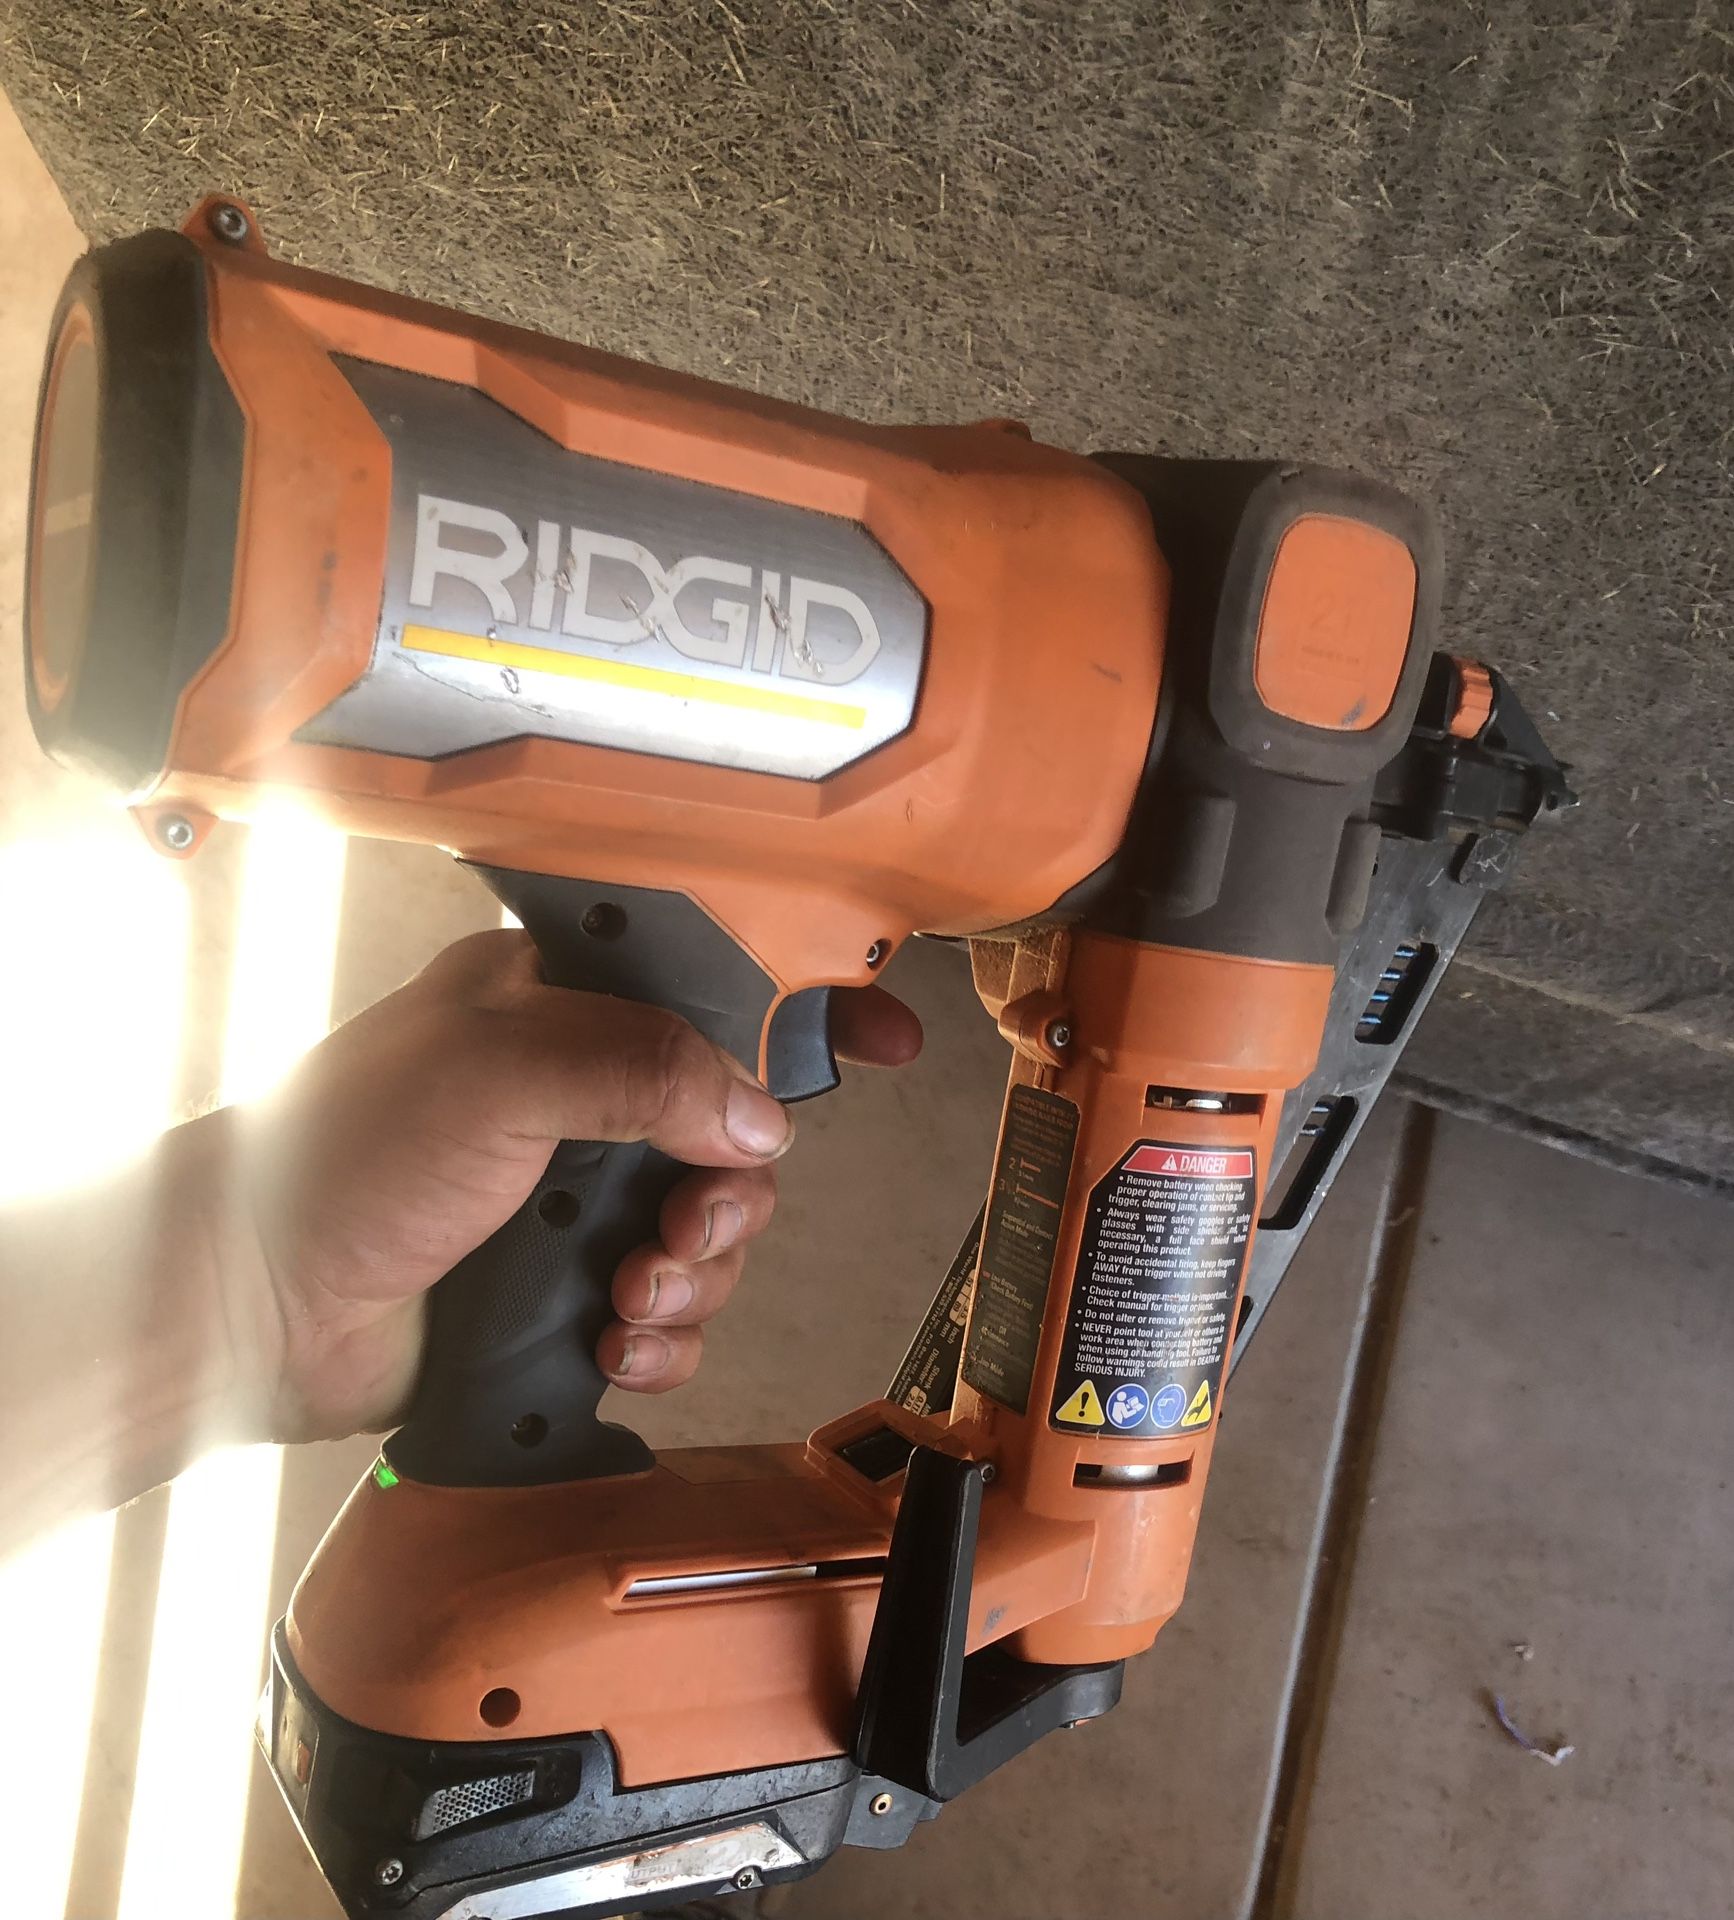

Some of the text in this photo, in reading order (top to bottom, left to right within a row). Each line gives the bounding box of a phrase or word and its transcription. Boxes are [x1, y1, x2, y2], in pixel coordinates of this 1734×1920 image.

[409, 494, 882, 687] RIDGID
[1180, 1155, 1227, 1173] DANGER
[1127, 1175, 1161, 1188] Remove
[1164, 1181, 1192, 1191] battery
[1195, 1183, 1214, 1191] when
[1117, 1186, 1146, 1198] proper
[1150, 1190, 1187, 1201] operation
[1190, 1192, 1199, 1201] of
[1109, 1194, 1140, 1207] trigger,
[1142, 1199, 1175, 1212] clearing
[1177, 1202, 1198, 1212] jams,
[1107, 1208, 1140, 1221] Always
[1145, 1214, 1166, 1223] wear
[1171, 1216, 1195, 1227] safety
[1102, 1218, 1136, 1230] glasses
[1146, 1223, 1165, 1233] with
[1173, 1226, 1189, 1235] side
[1100, 1229, 1146, 1243] necessary,
[1169, 1235, 1182, 1244] full
[1190, 1236, 1204, 1245] face
[1098, 1240, 1140, 1253] operating
[1143, 1244, 1158, 1253] this
[1096, 1252, 1106, 1261] To
[1109, 1253, 1132, 1265] avoid
[1135, 1256, 1177, 1268] accidental
[1201, 1260, 1216, 1269] keep
[1092, 1272, 1134, 1285] fasteners.
[1093, 1262, 1119, 1273] AWAY
[1122, 1266, 1142, 1276] from
[1144, 1267, 1171, 1279] trigger
[1173, 1269, 1193, 1278] when
[1195, 1269, 1205, 1279] not
[1089, 1286, 1119, 1297] Choice
[1122, 1289, 1131, 1298] of
[1133, 1290, 1161, 1302] trigger
[1087, 1296, 1118, 1308] Check
[1117, 1300, 1148, 1311] manual
[1151, 1303, 1162, 1312] for
[1164, 1301, 1188, 1313] trigger
[1085, 1309, 1096, 1319] Do
[1100, 1311, 1114, 1321] not
[1116, 1313, 1135, 1323] alter
[1138, 1315, 1146, 1323] or
[1148, 1317, 1176, 1325] remove
[1082, 1323, 1111, 1335] NEVER
[1113, 1327, 1135, 1337] point
[1138, 1327, 1152, 1337] tool
[1155, 1328, 1163, 1338] at
[1080, 1333, 1103, 1344] work
[1105, 1337, 1124, 1346] area
[1127, 1339, 1149, 1348] when
[1078, 1344, 1104, 1354] when
[1105, 1347, 1128, 1358] using
[1131, 1349, 1139, 1357] or
[1076, 1353, 1104, 1365] follow
[1106, 1357, 1145, 1368] warnings
[1169, 1356, 1189, 1368] result
[1197, 1354, 1215, 1366] DEATH
[922, 1364, 940, 1390] Shank
[1074, 1363, 1146, 1378] SERIOUS INJURY.
